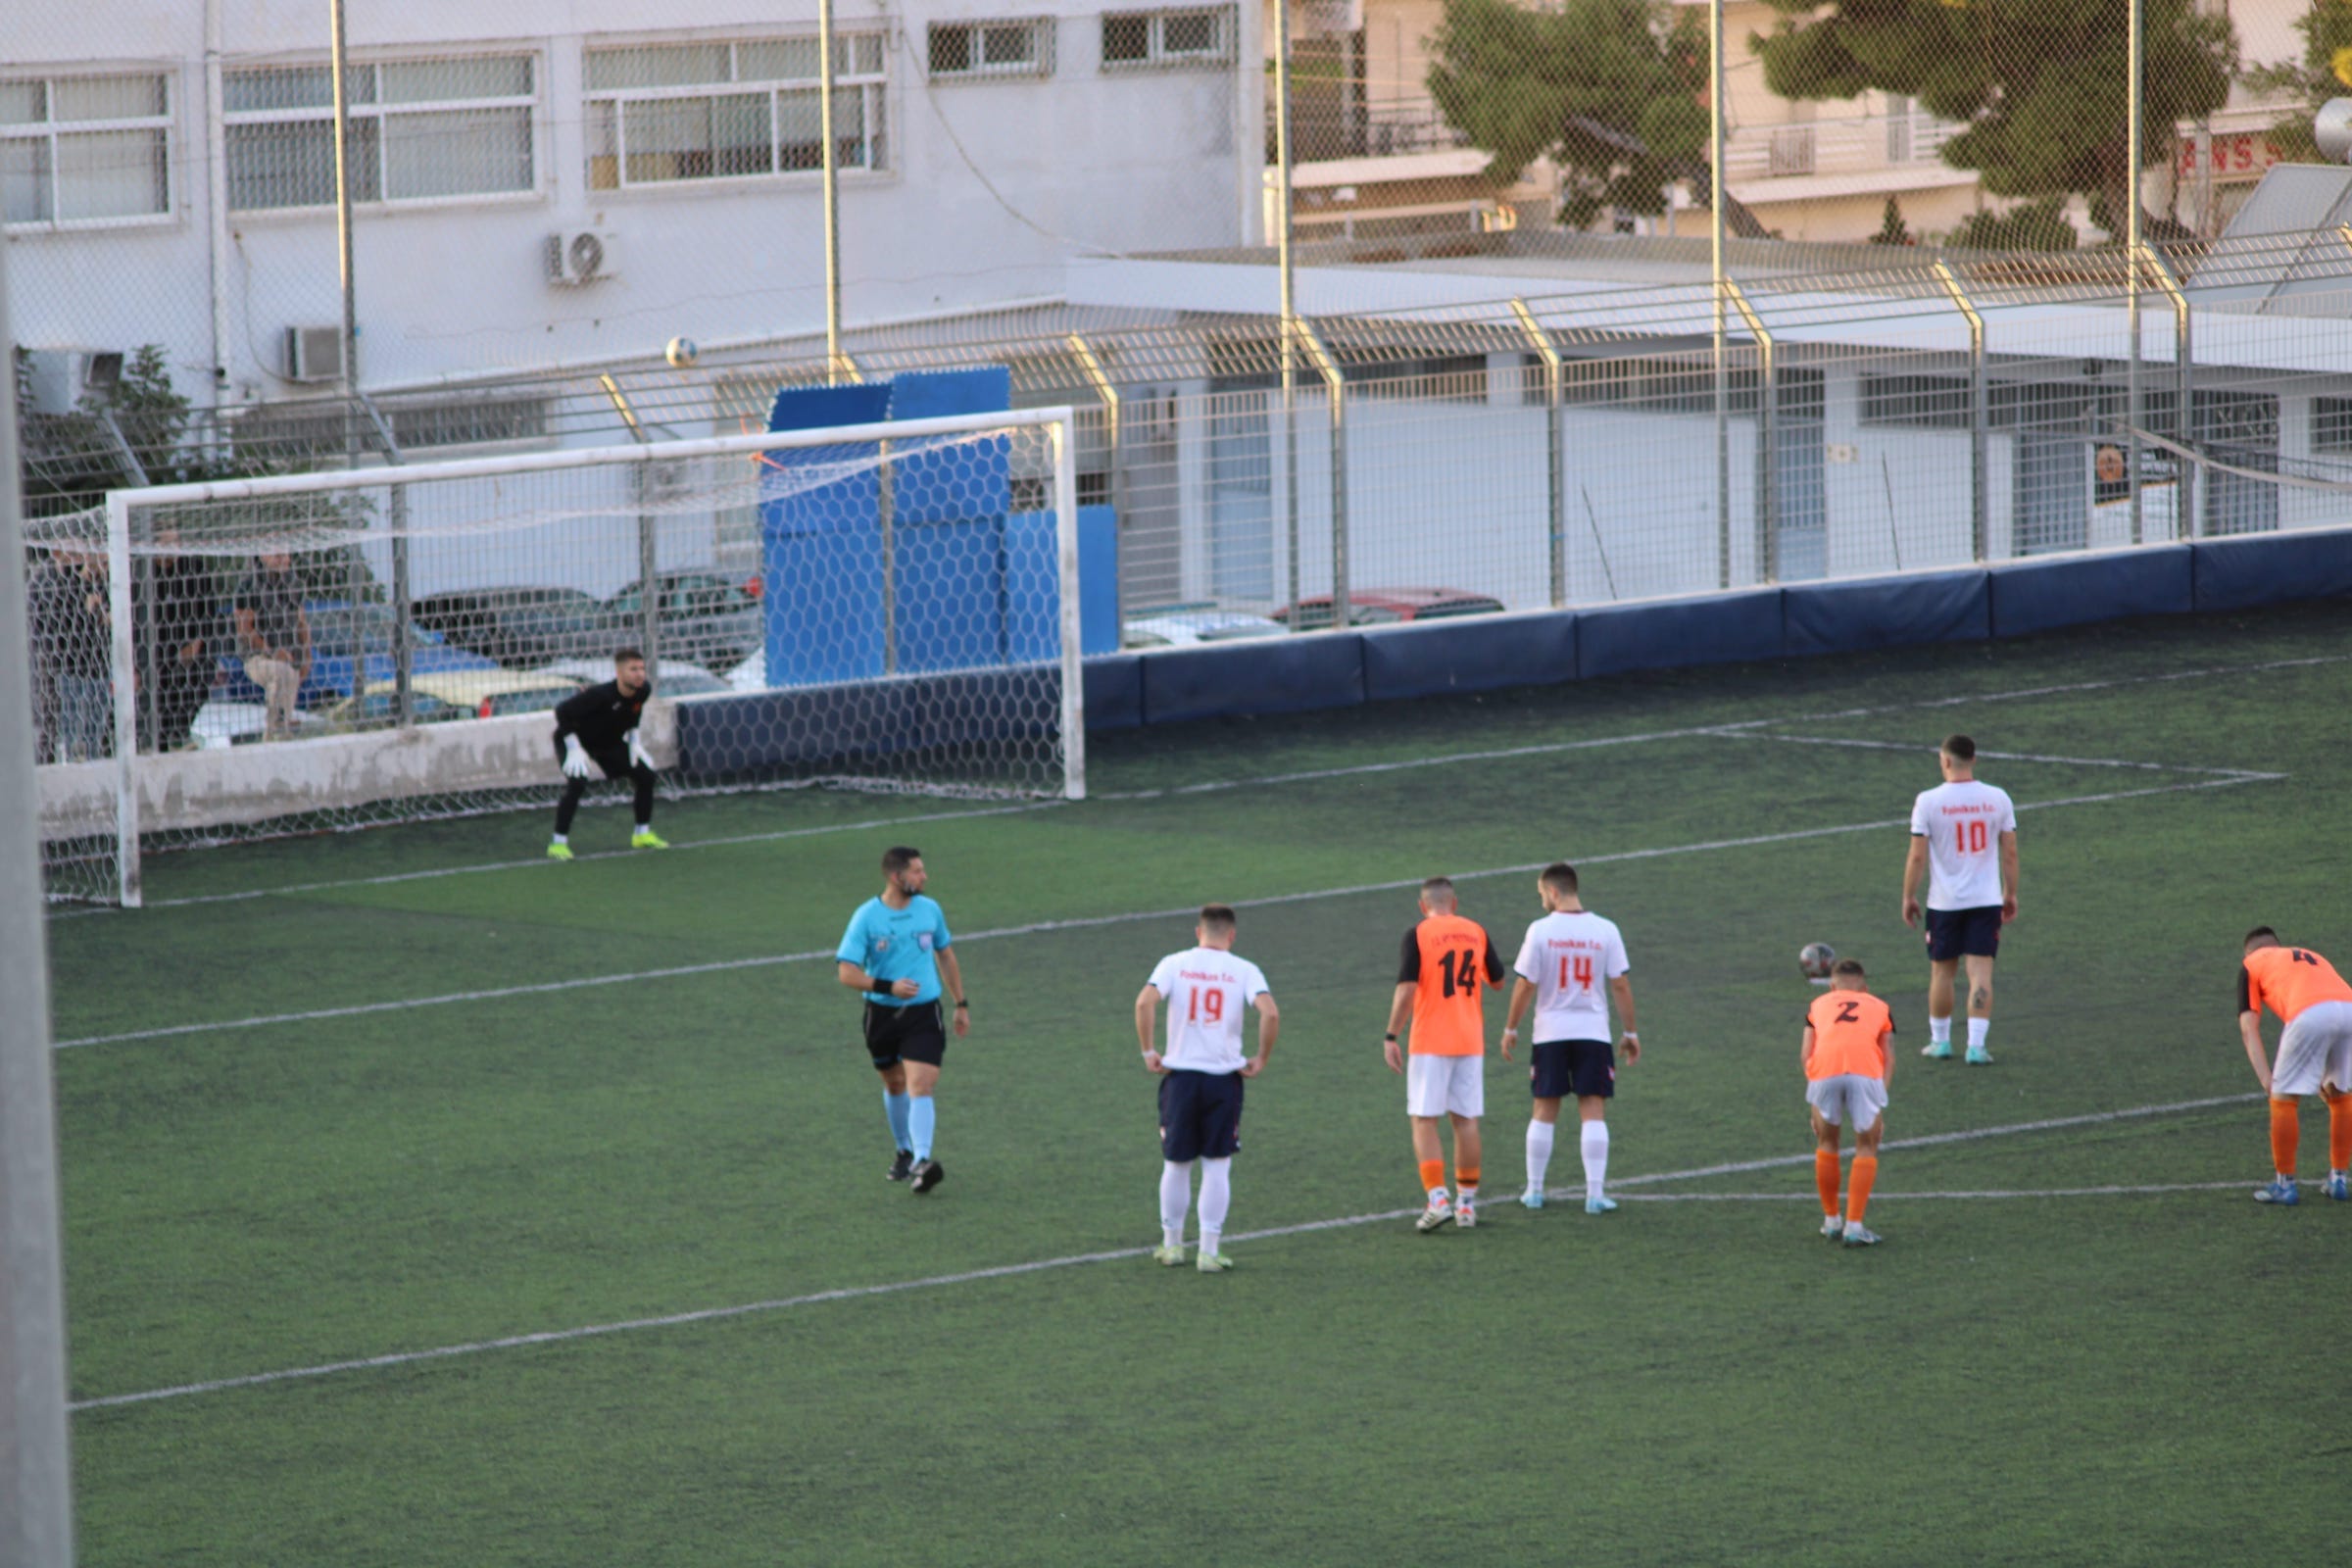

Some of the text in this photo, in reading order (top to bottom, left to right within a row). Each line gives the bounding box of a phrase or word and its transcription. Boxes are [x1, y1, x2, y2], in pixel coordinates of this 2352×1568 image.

[1956, 819, 1987, 855] 10
[1439, 949, 1476, 999] 14
[1558, 955, 1593, 991] 14
[2292, 949, 2318, 965] 4
[1189, 985, 1224, 1024] 19
[1834, 1002, 1859, 1023] 2
